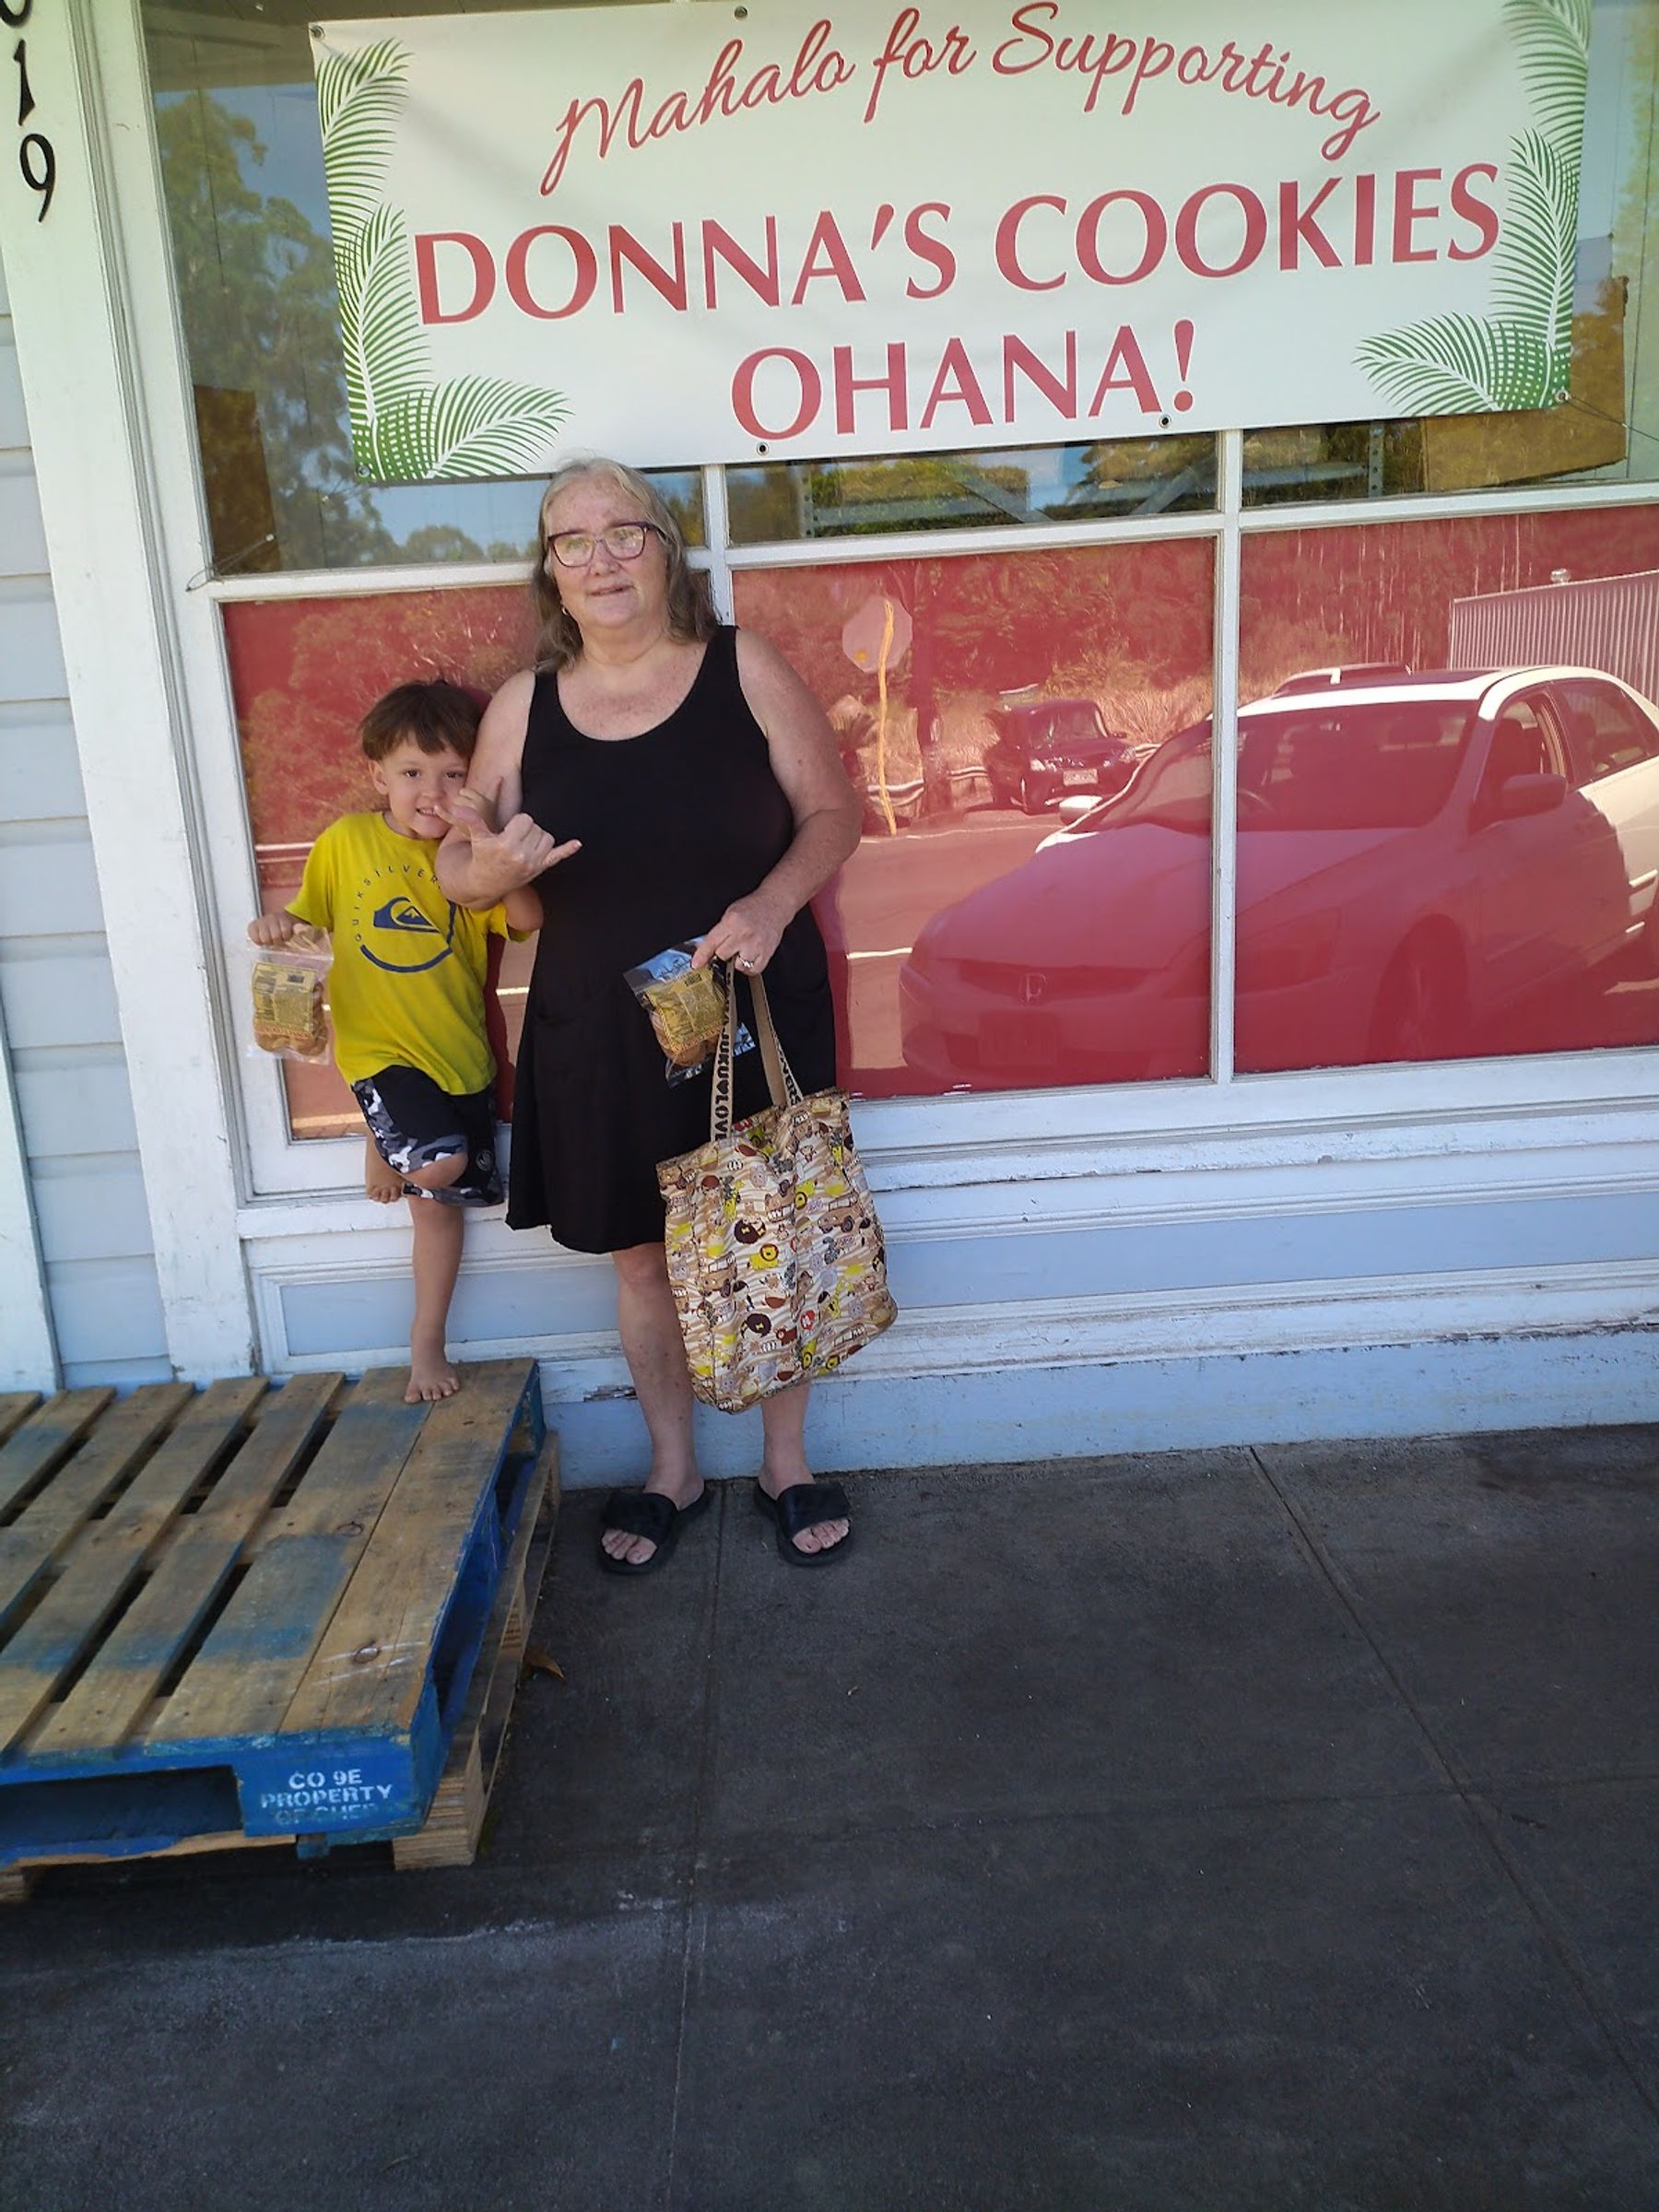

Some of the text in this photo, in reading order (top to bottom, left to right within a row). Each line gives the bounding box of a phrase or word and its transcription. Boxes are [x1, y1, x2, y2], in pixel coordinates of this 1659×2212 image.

[540, 1, 1381, 196] Mahalo for Supporting
[414, 164, 1500, 326] DONNA'S COOKIES
[731, 319, 1195, 441] OHANA!
[261, 1783, 393, 1809] PROPERTY
